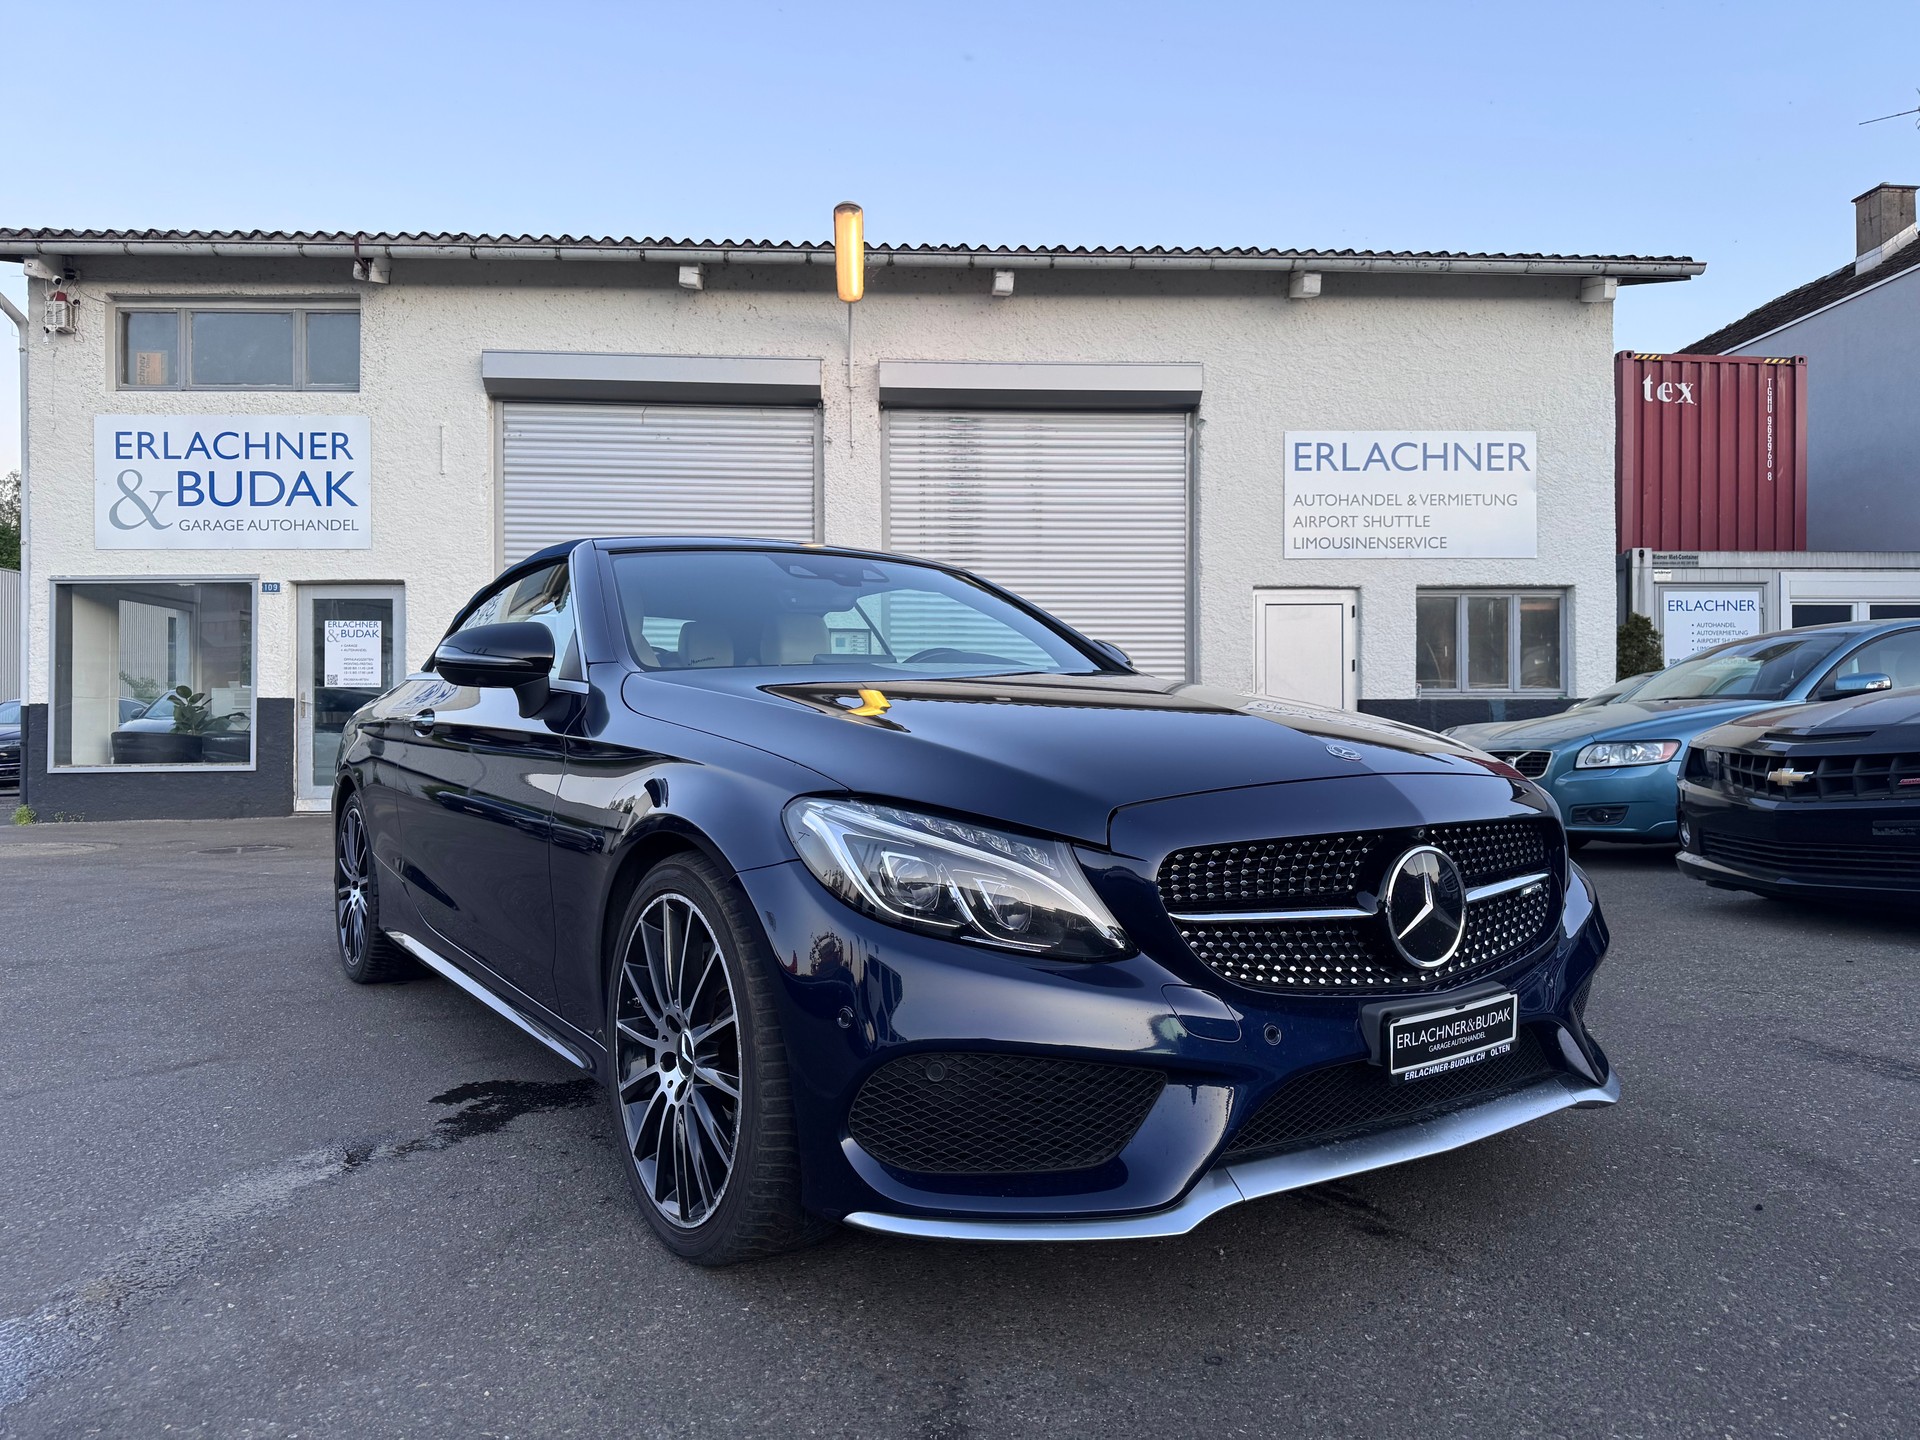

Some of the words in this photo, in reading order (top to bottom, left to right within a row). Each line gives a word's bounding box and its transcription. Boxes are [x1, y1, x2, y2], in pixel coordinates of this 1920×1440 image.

[1642, 374, 1695, 404] tex
[115, 431, 354, 460] ERLACHNER
[1294, 442, 1531, 472] ERLACHNER
[1767, 472, 1773, 481] 8
[109, 469, 173, 531] &
[177, 470, 359, 507] BUDAK
[1293, 494, 1402, 507] AUTOHANDEL
[1407, 494, 1417, 507] &
[1420, 493, 1518, 507] VERMIETUNG
[178, 519, 244, 532] GARAGE
[247, 519, 359, 532] AUTOHANDEL
[1293, 515, 1358, 528] AIRPORT
[1363, 515, 1431, 528] SHUTTLE
[1293, 536, 1448, 550] LIMOUSINENSERVICE
[264, 583, 278, 591] 109
[1667, 599, 1756, 612] ERLACHNER
[340, 629, 379, 638] BUDAK
[1428, 1040, 1452, 1053] GARAGE
[1450, 1031, 1486, 1047] AUTOHANDEL
[1404, 1051, 1486, 1081] ERLACHNER-BUDAK.CH
[1490, 1043, 1511, 1057] OLTEN
